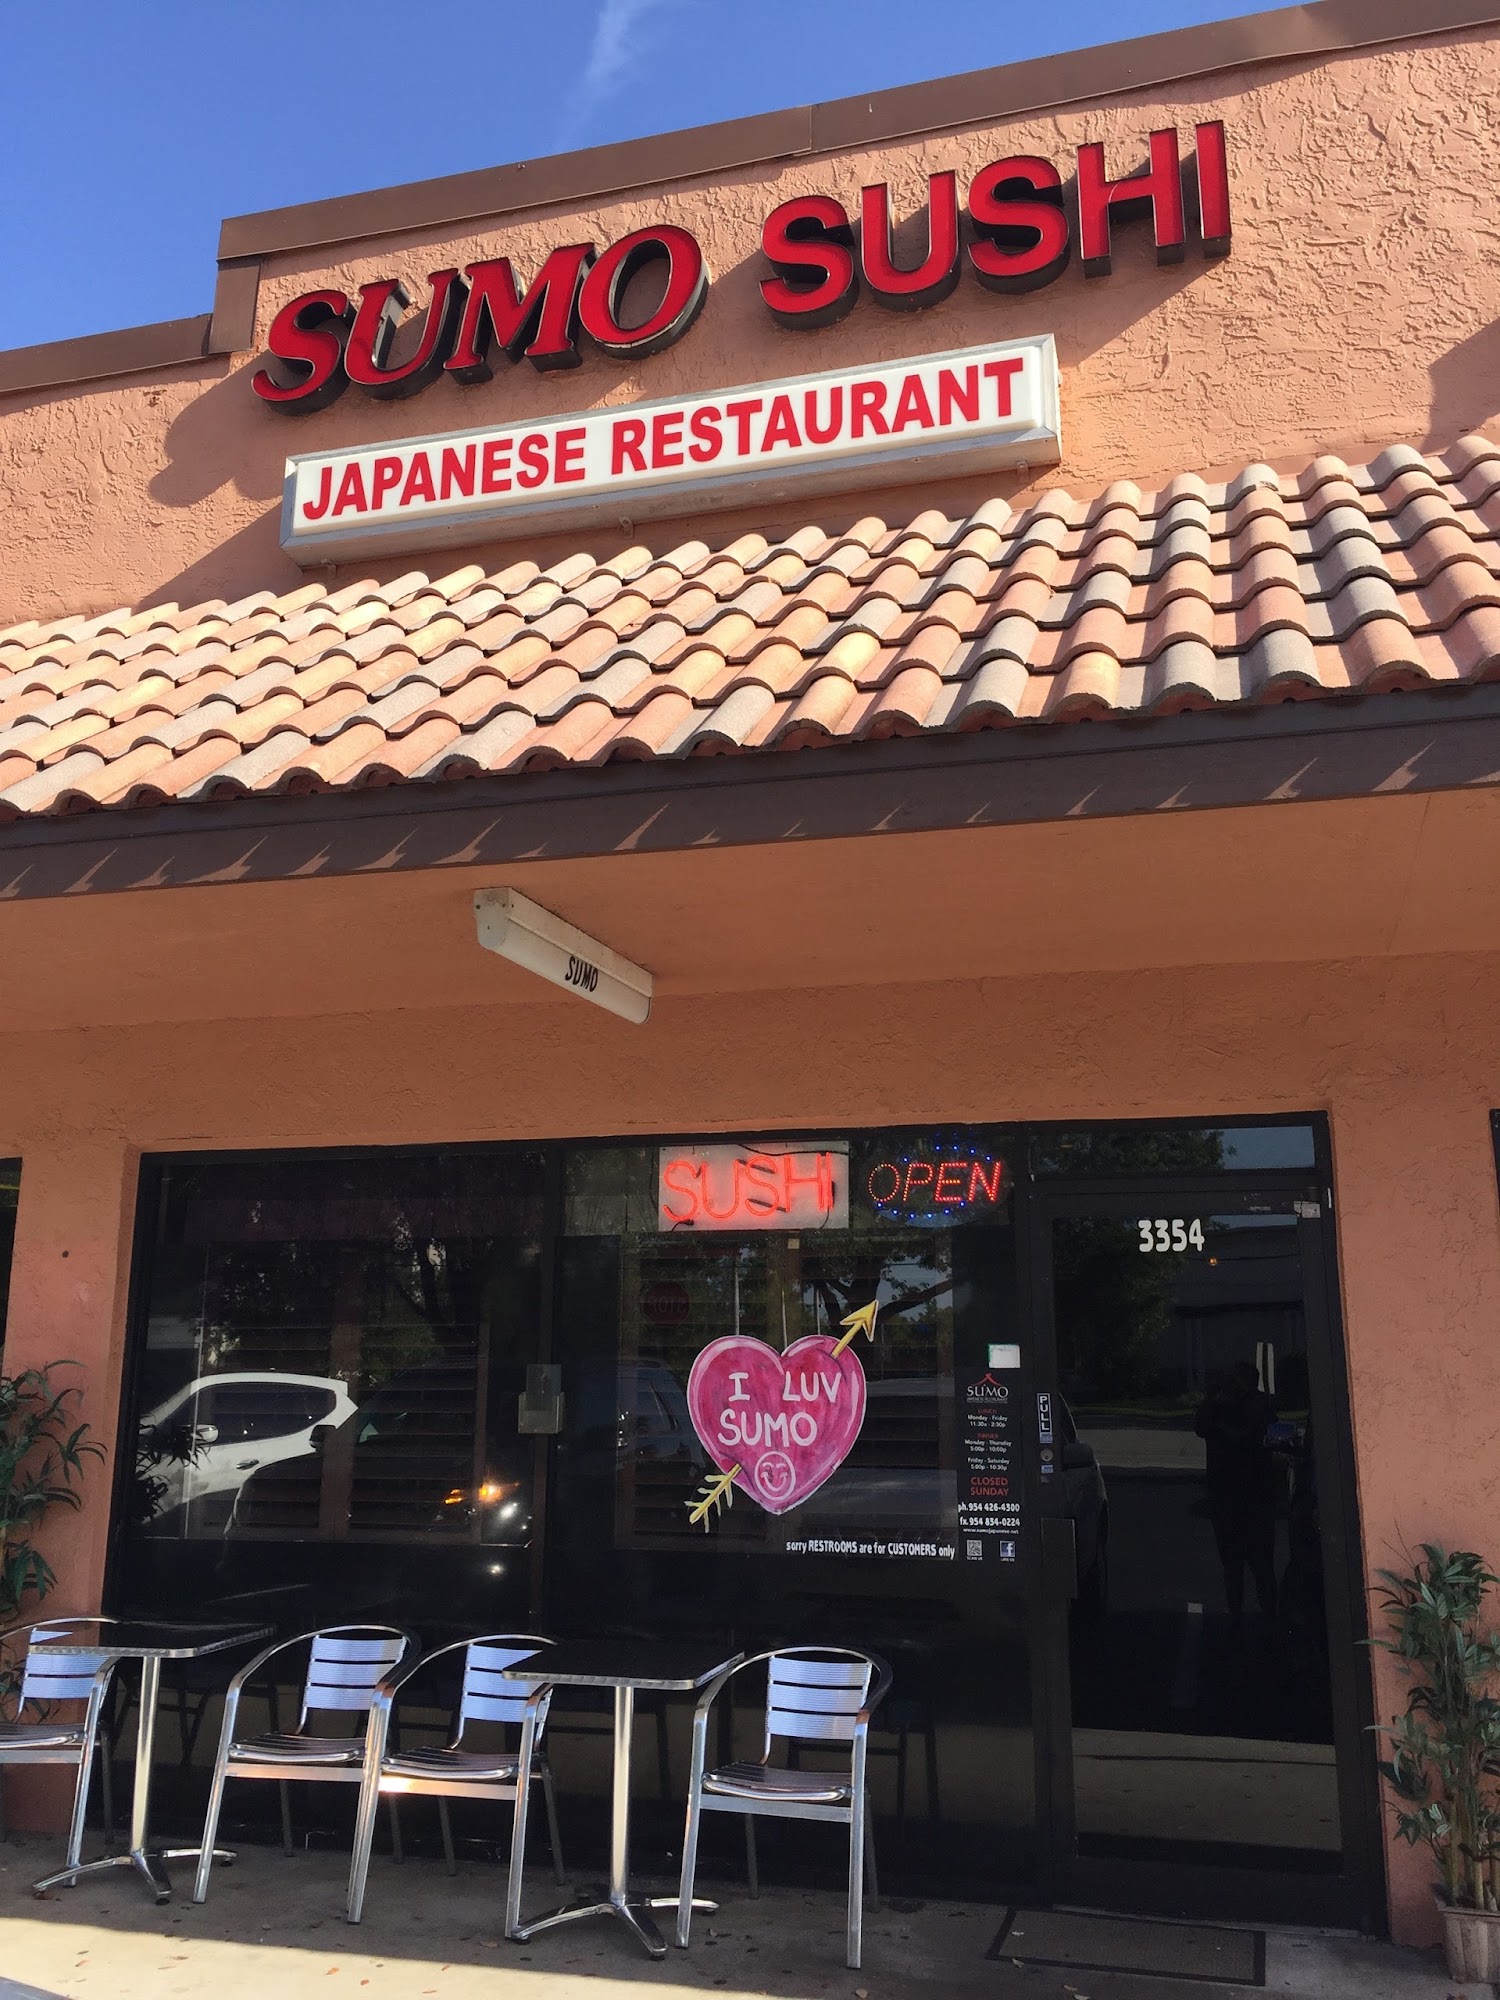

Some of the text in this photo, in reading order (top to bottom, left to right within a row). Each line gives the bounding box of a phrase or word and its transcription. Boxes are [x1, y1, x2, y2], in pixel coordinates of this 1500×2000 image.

[251, 119, 1232, 402] SUMO SUSHI
[302, 356, 1025, 521] JAPANESE RESTAURANT
[565, 955, 600, 992] SUMO
[662, 1152, 835, 1222] SUSHI
[868, 1160, 1002, 1203] OPEN
[1138, 1218, 1205, 1252] 3354
[728, 1371, 842, 1403] I LUV
[966, 1385, 1009, 1398] SUMO
[717, 1408, 818, 1448] SUMO
[1040, 1395, 1050, 1431] PULL
[965, 1438, 985, 1446] Monday
[989, 1439, 1013, 1447] Thursday
[987, 1457, 1010, 1465] Saturday
[970, 1477, 1009, 1486] CLOSED
[970, 1486, 1009, 1496] SUNDAY
[984, 1503, 1020, 1512] 426-4300
[985, 1517, 1020, 1526] 834-0224
[786, 1539, 956, 1560] sorry RESTROOMS are for CUSTOMERS only
